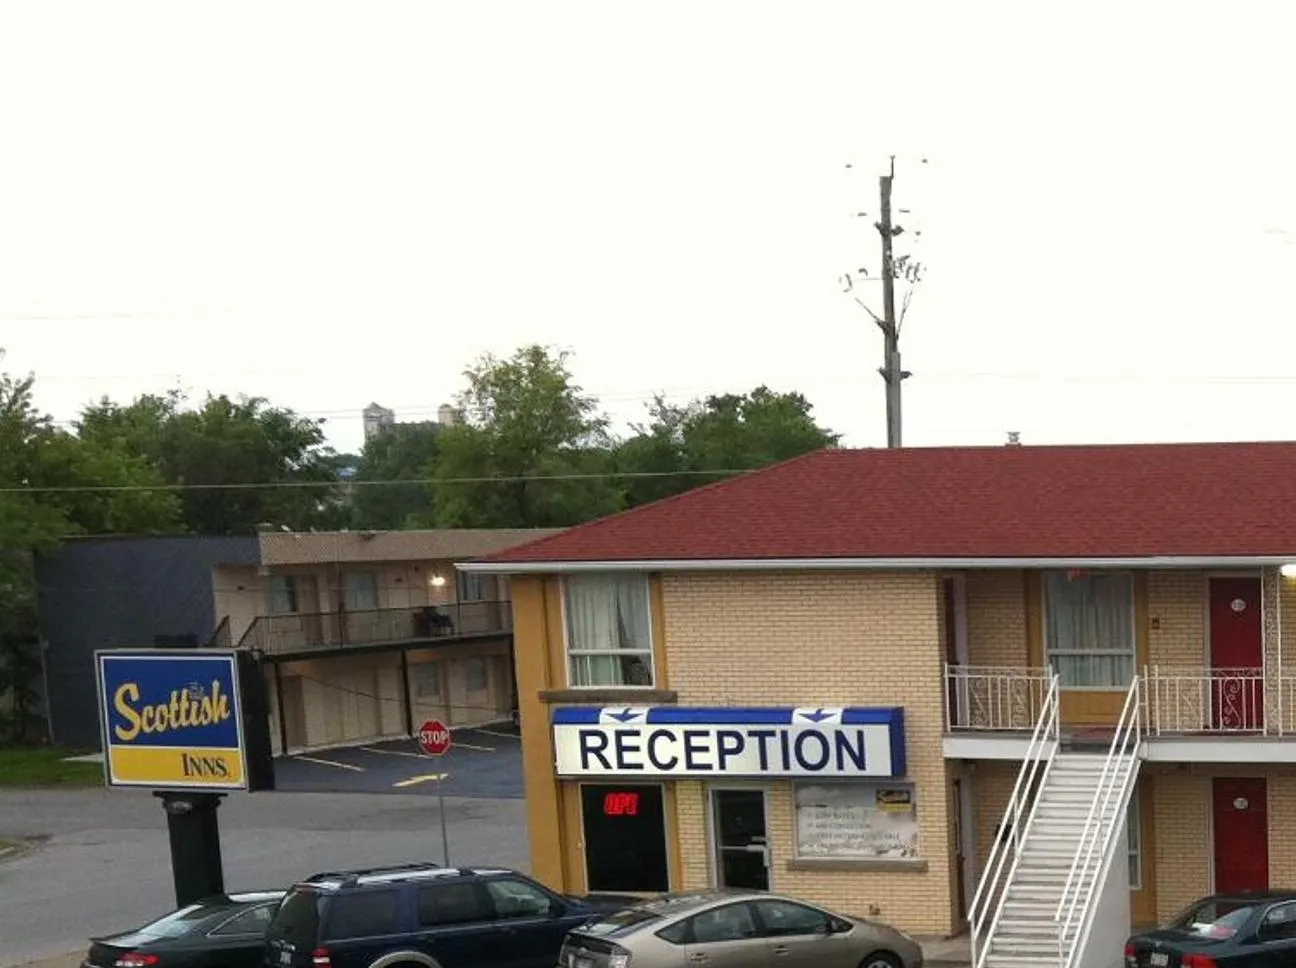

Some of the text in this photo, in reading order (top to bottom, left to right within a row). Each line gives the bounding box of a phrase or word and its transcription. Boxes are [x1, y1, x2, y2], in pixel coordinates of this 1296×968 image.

[114, 679, 231, 741] Scottish
[420, 730, 448, 745] STOP
[578, 728, 867, 772] RECEPTION
